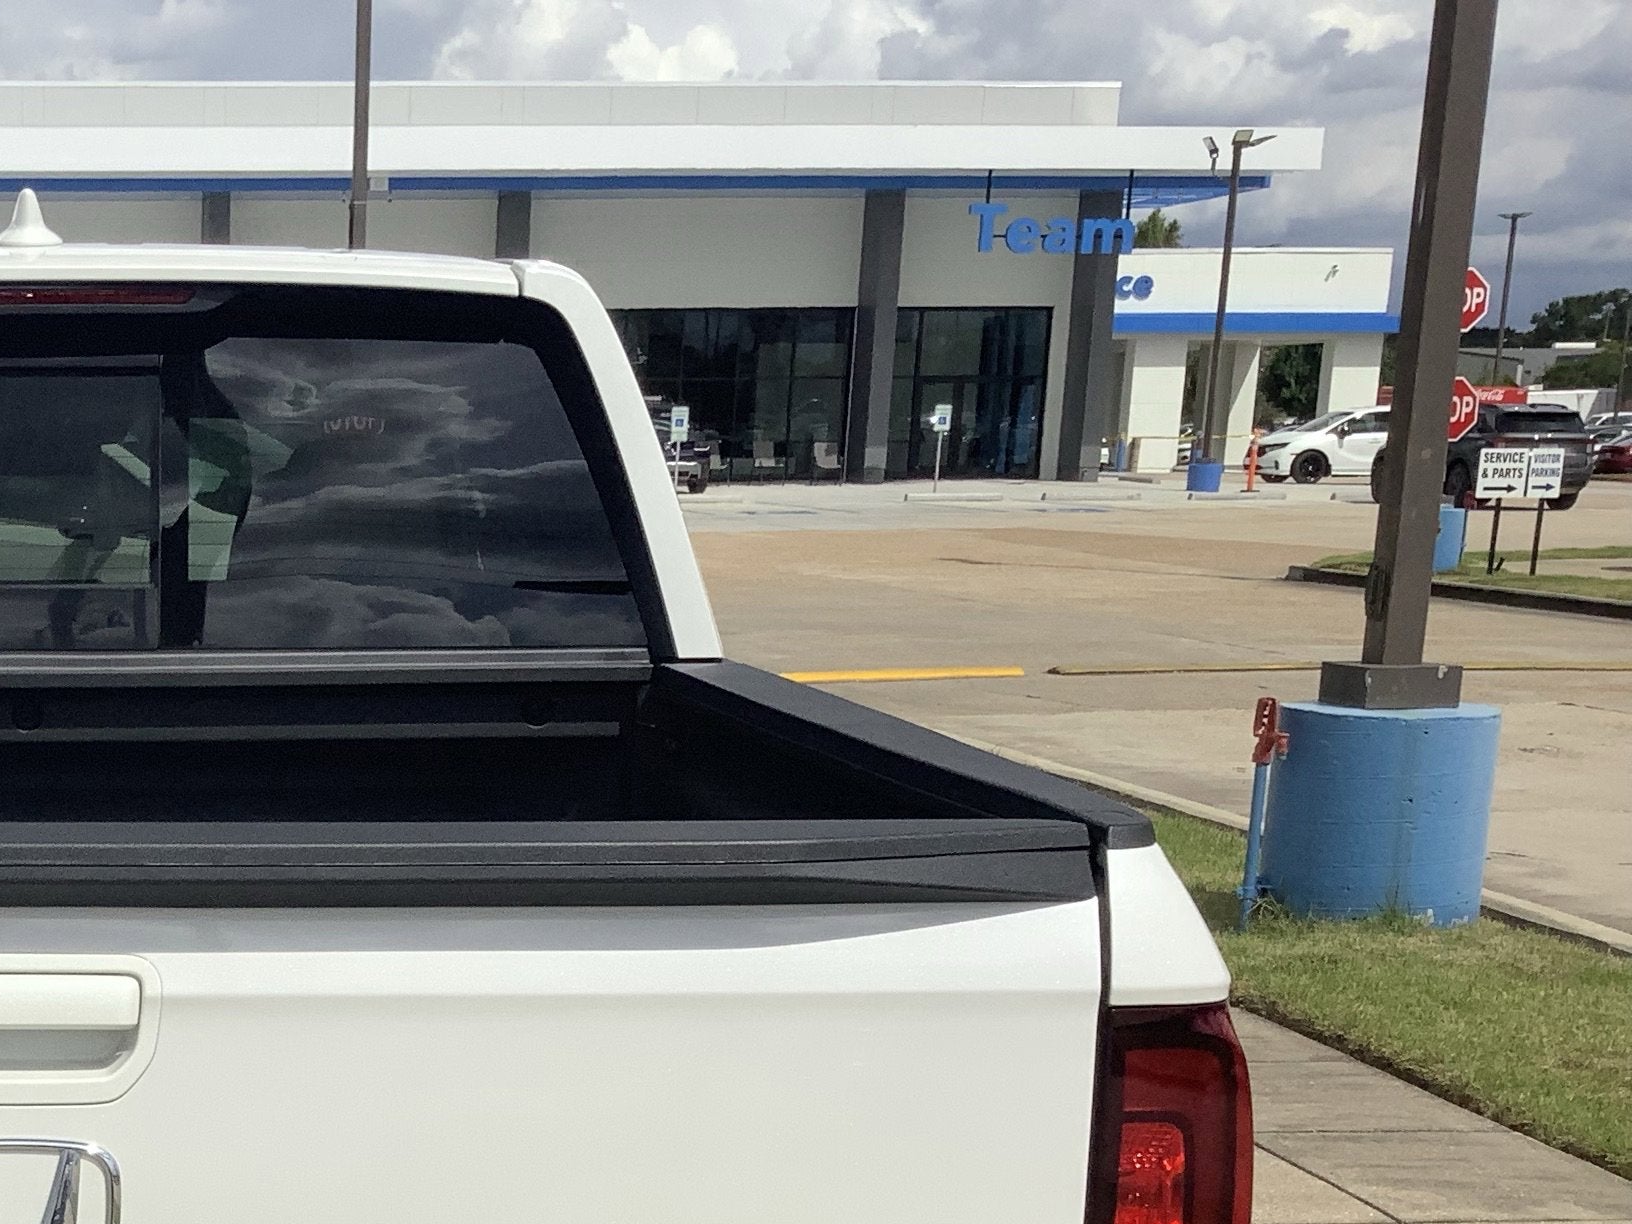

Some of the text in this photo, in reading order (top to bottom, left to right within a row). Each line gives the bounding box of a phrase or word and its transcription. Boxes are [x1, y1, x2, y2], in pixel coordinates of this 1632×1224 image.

[969, 203, 1135, 254] Team
[1462, 287, 1485, 313] OP
[1449, 396, 1474, 423] OP
[1483, 452, 1525, 463] SERVICE
[1534, 454, 1561, 464] VISITOR
[1481, 468, 1524, 479] & PARTS
[1531, 467, 1561, 478] PARKING
